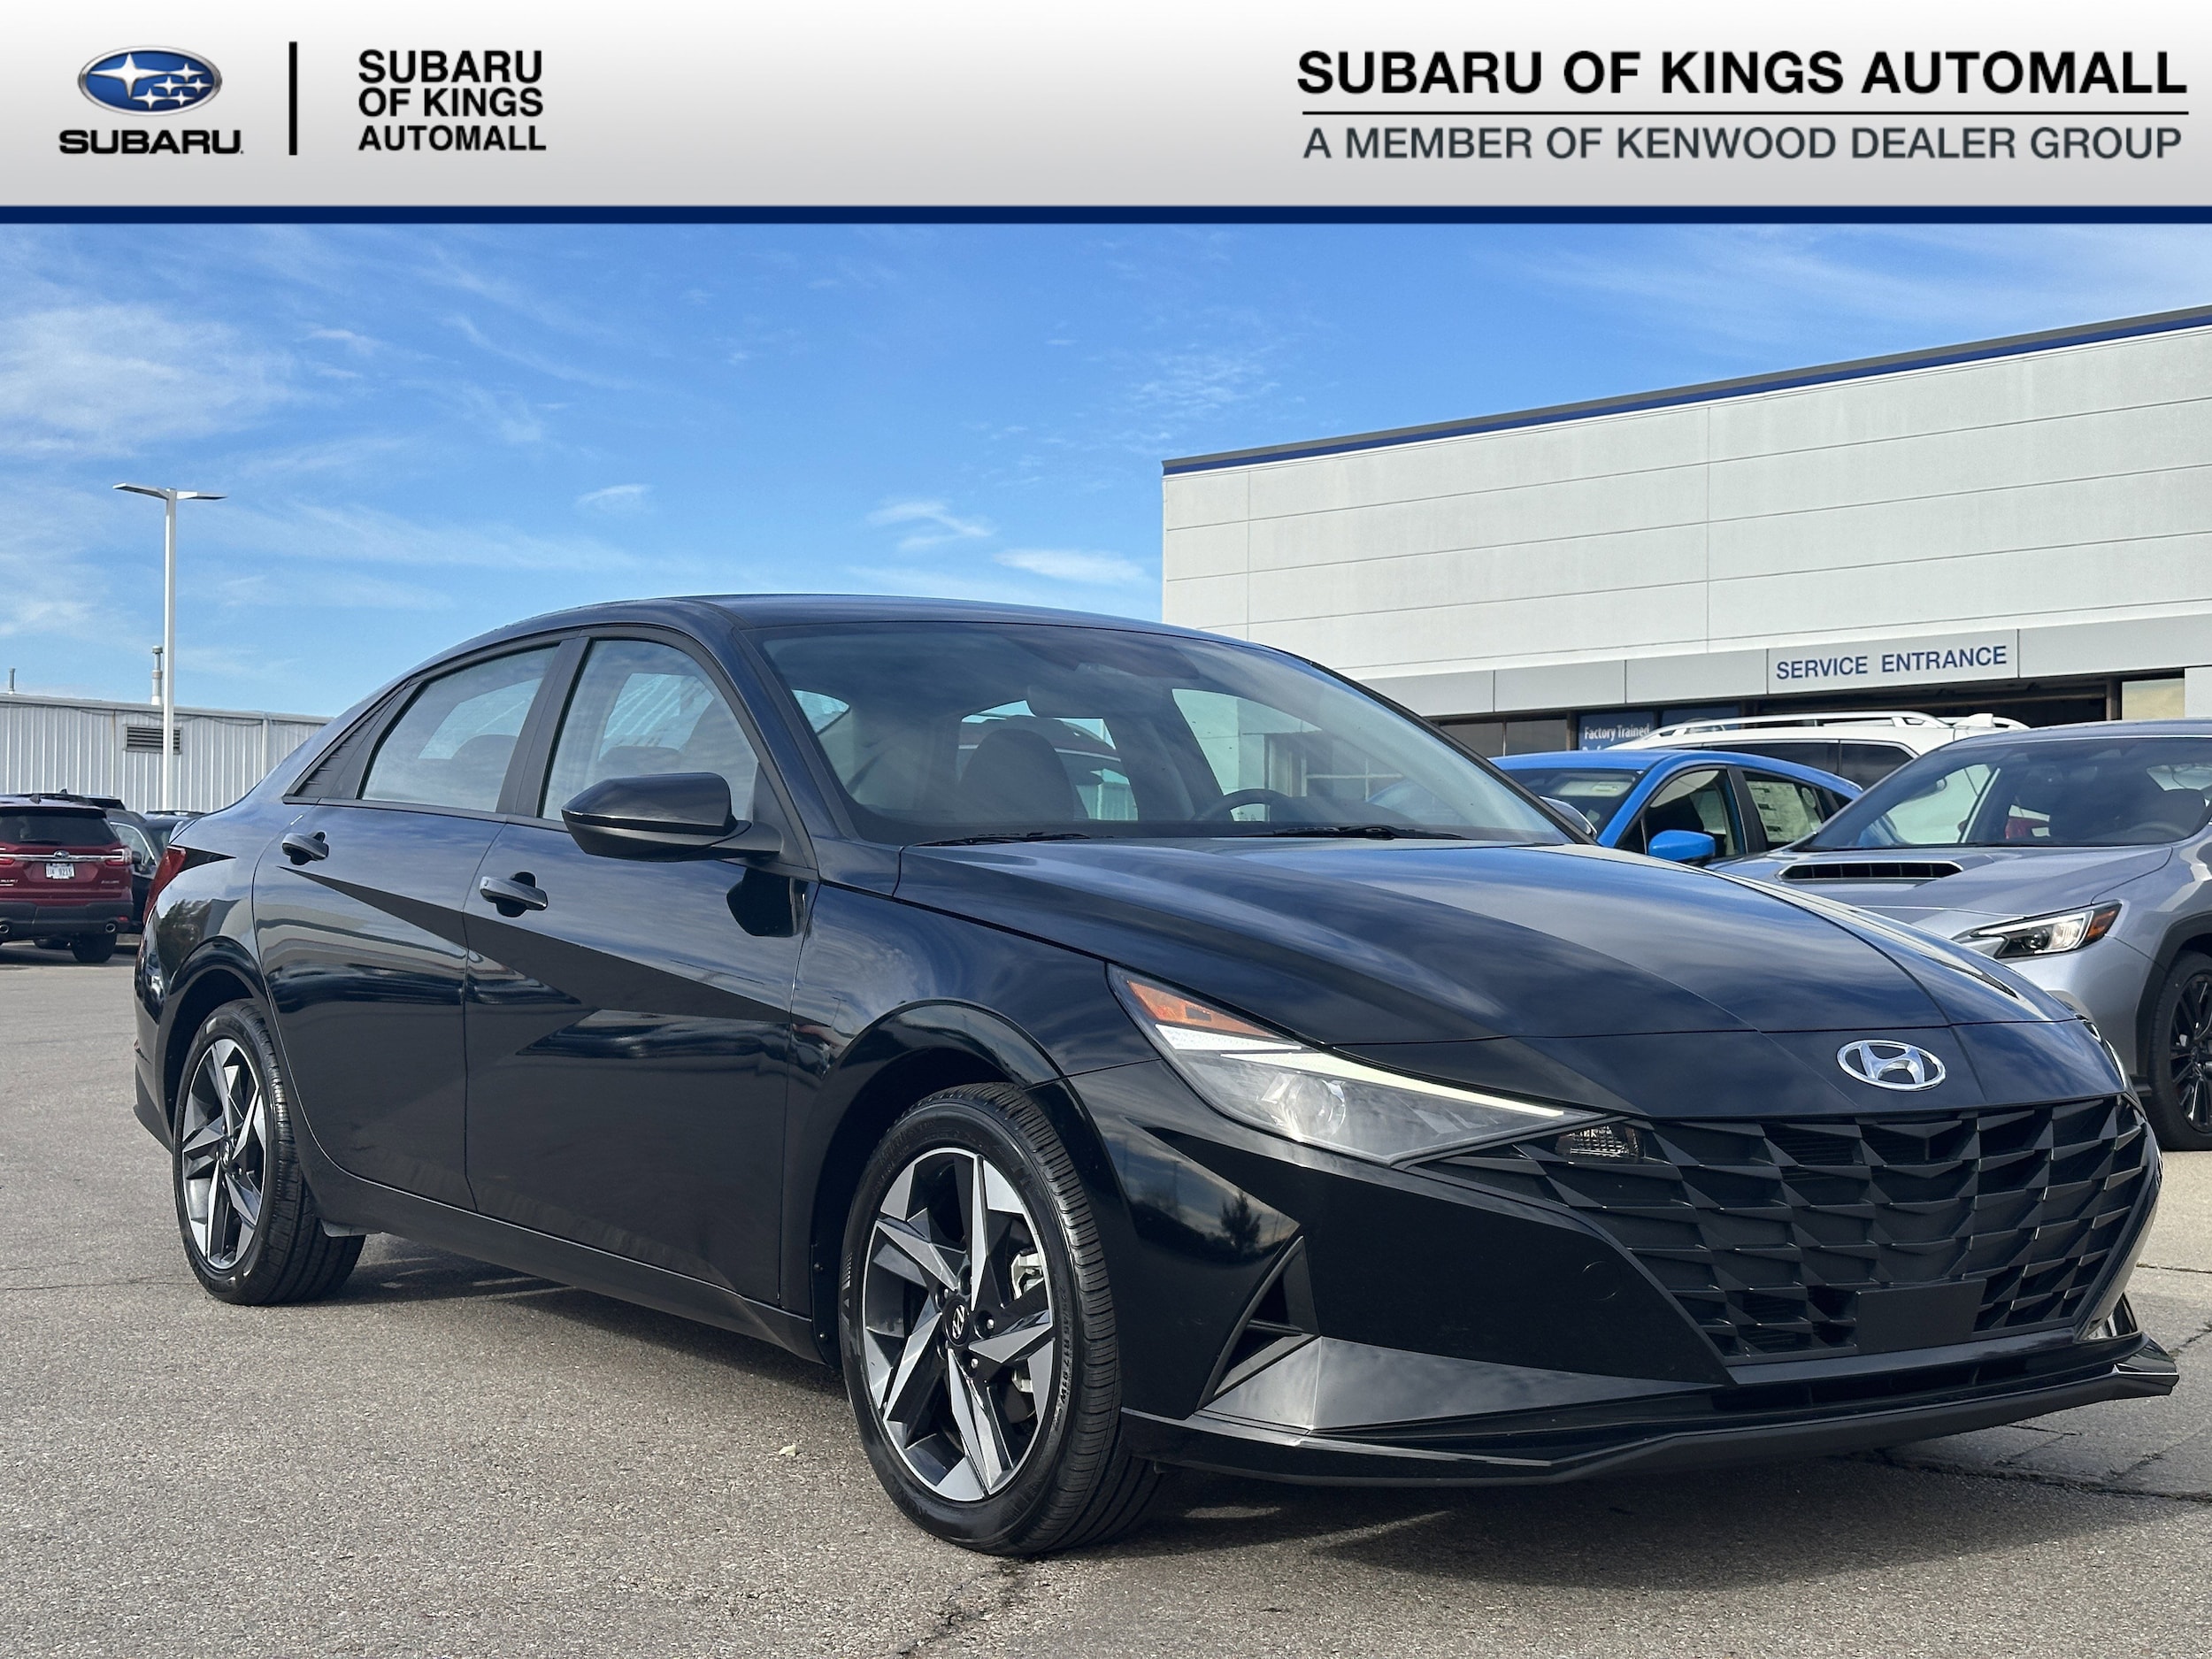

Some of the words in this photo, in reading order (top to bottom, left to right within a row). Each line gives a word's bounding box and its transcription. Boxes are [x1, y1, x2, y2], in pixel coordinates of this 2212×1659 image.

[1776, 656, 1868, 680] SERVICE
[1881, 645, 2008, 673] ENTRANCE
[1584, 726, 1617, 741] Factory
[1617, 723, 1650, 739] Trained
